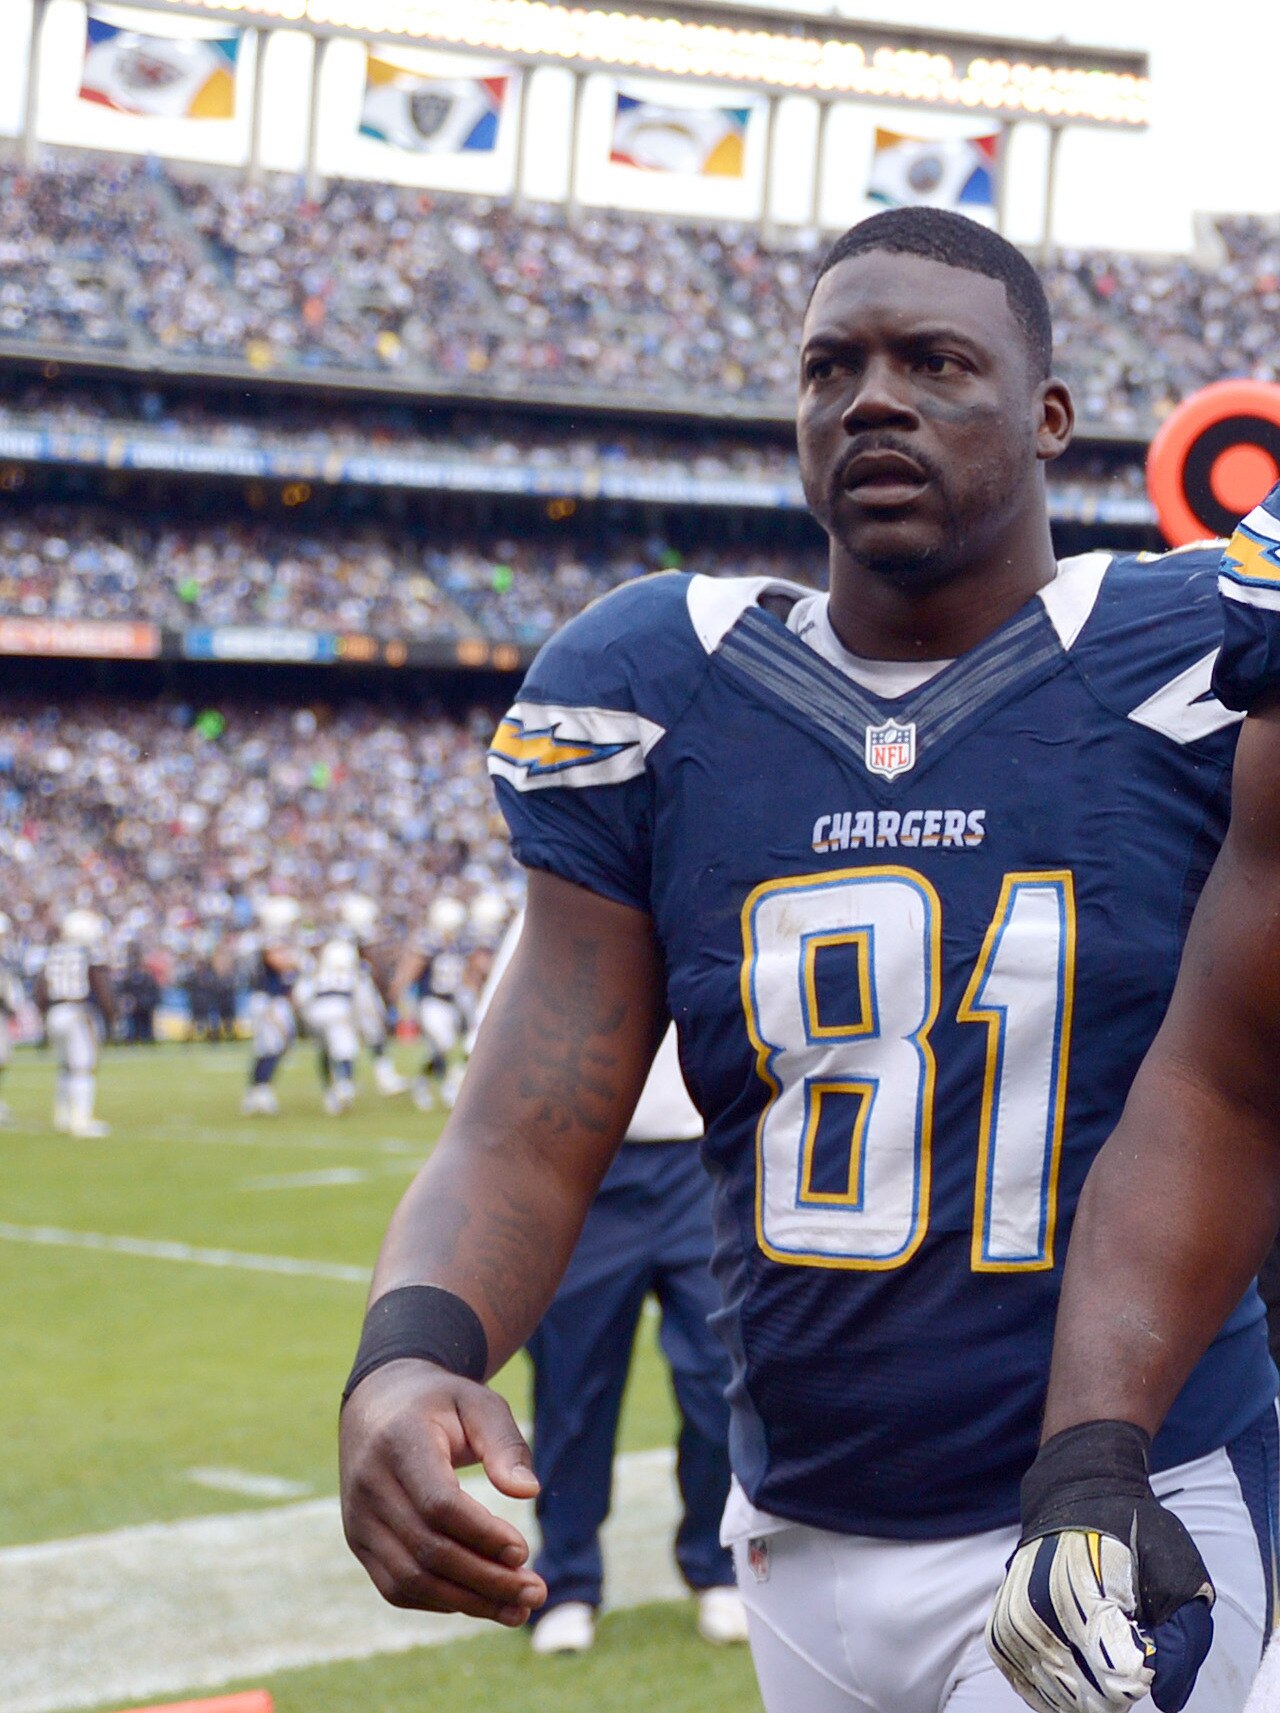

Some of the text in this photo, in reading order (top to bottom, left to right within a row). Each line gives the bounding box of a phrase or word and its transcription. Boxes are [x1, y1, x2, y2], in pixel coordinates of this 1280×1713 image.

[873, 745, 908, 768] NFL
[811, 809, 986, 854] CHARGERS
[740, 864, 1077, 1273] 81
